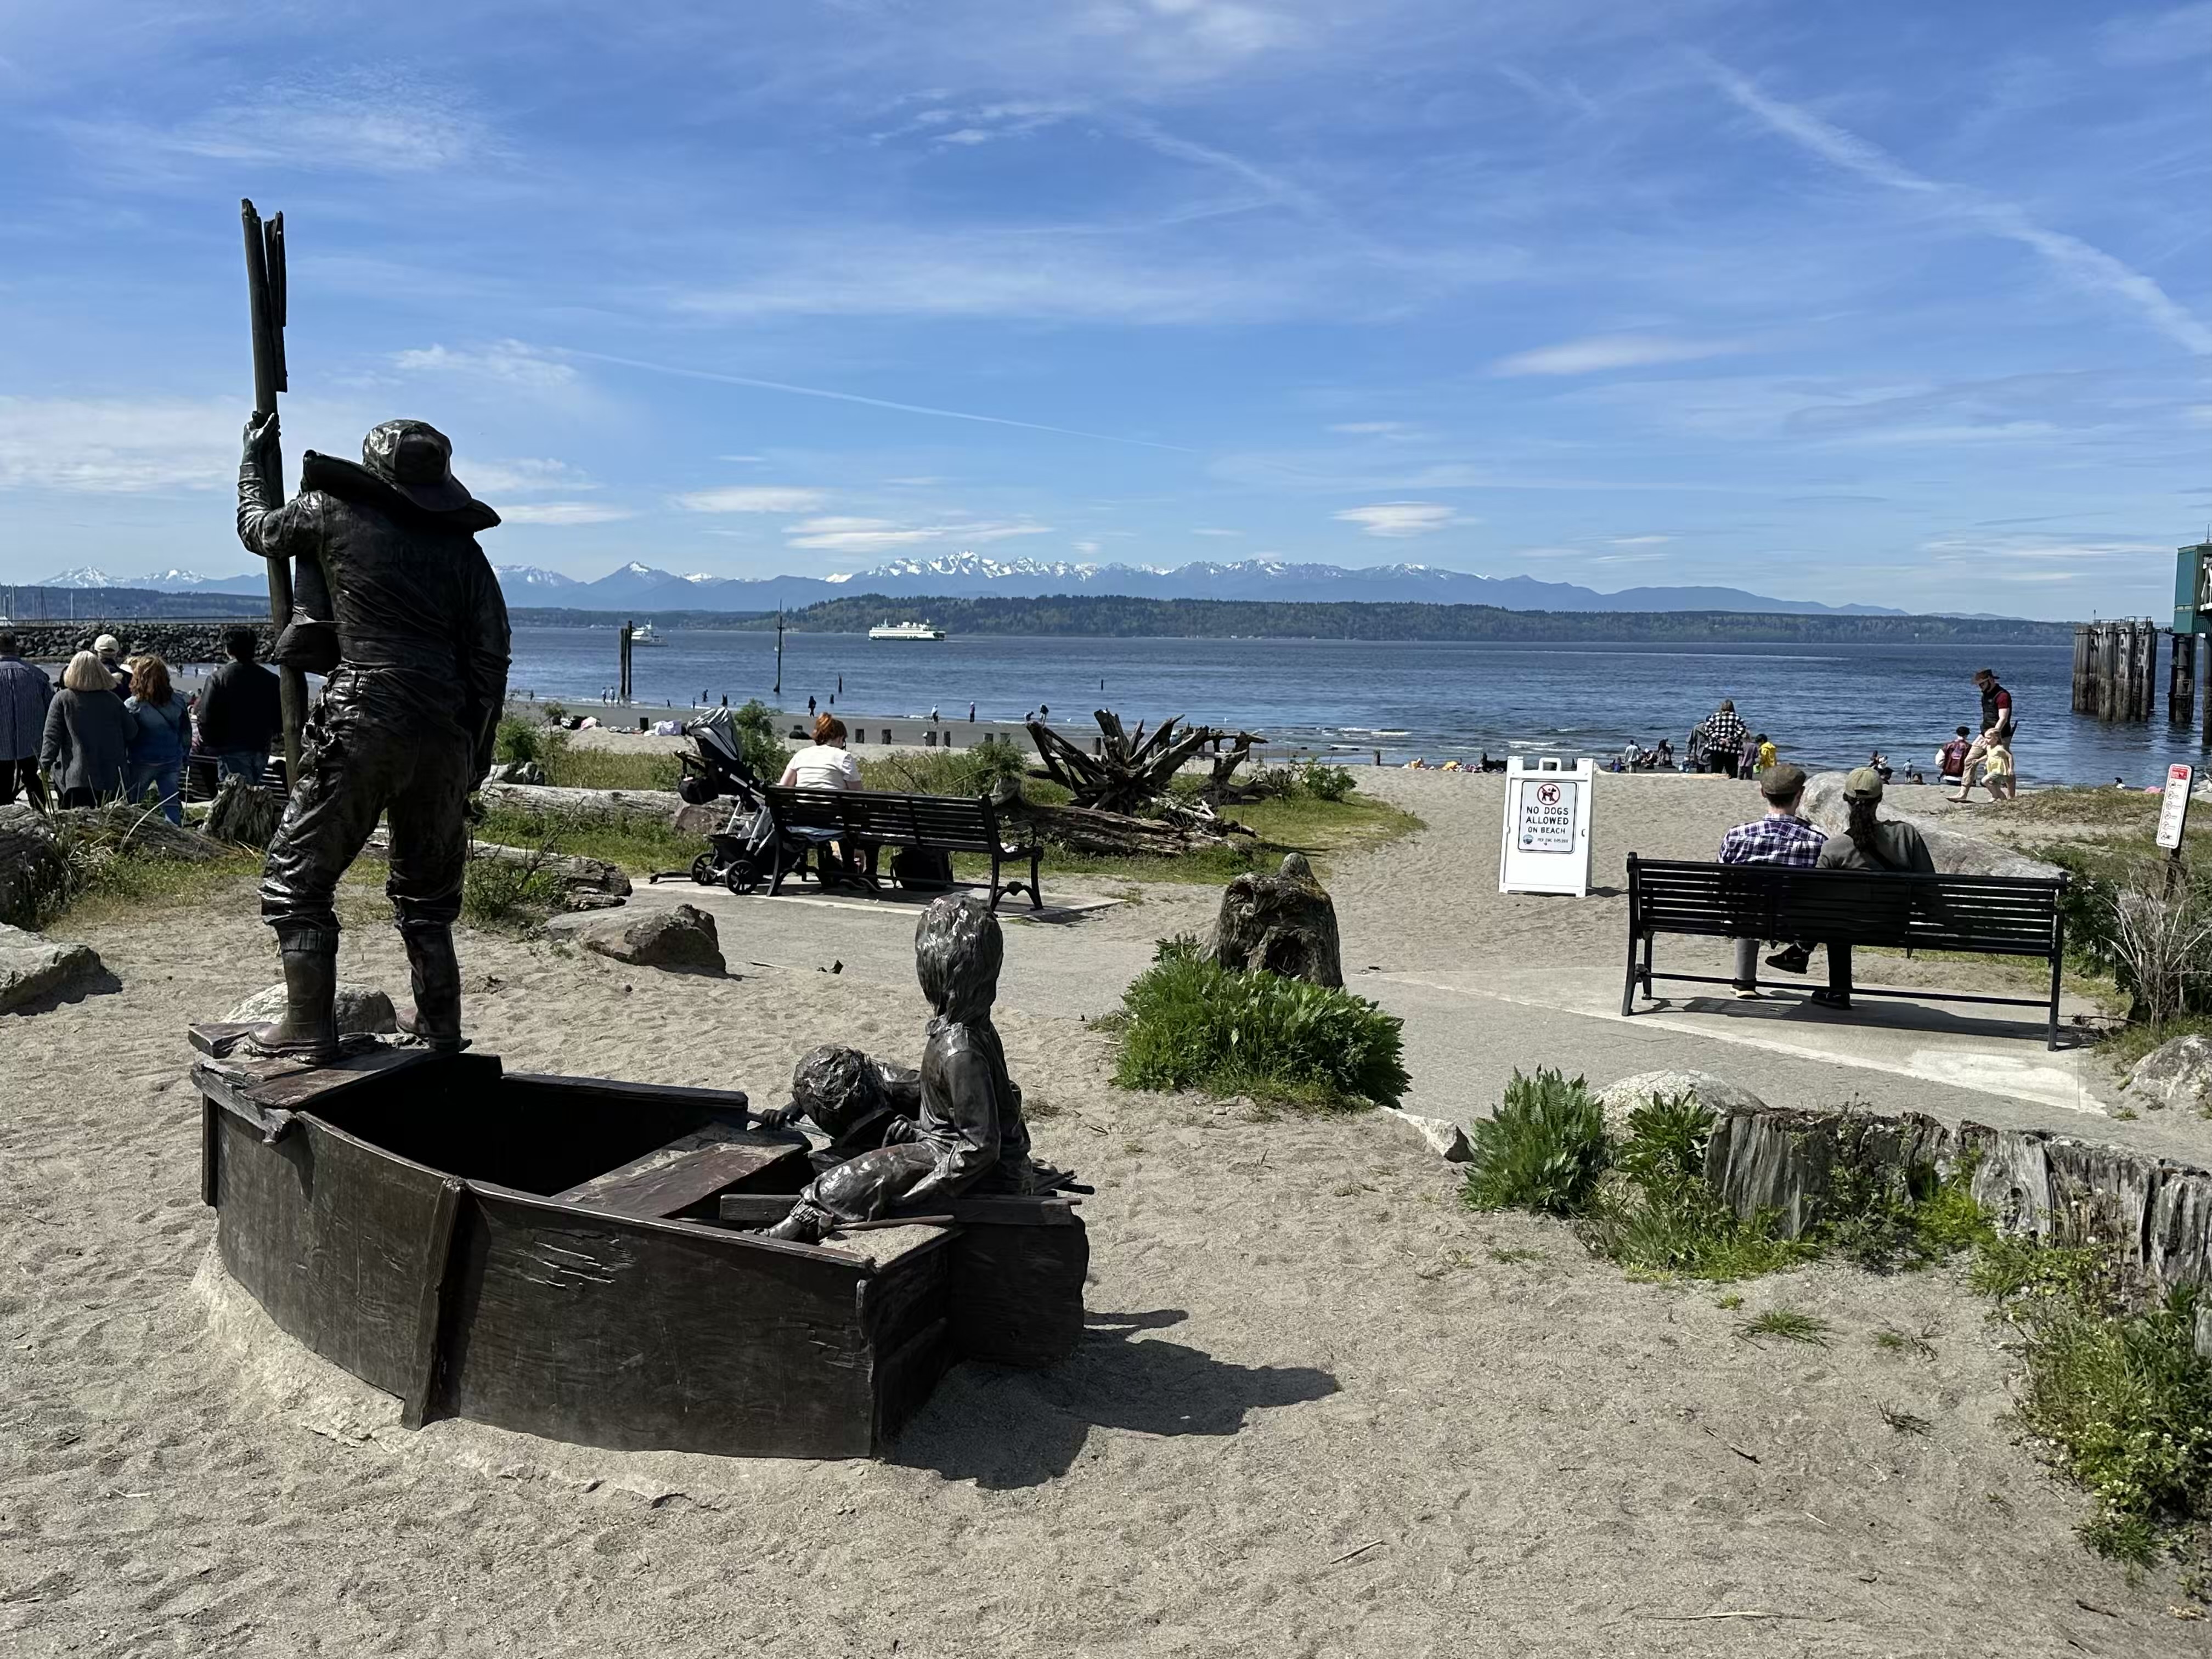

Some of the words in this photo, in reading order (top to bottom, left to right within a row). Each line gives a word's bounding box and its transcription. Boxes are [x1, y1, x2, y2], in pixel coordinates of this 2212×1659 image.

[1527, 806, 1539, 814] NO
[1544, 807, 1568, 815] DOGS
[1526, 816, 1568, 825] ALLOWED
